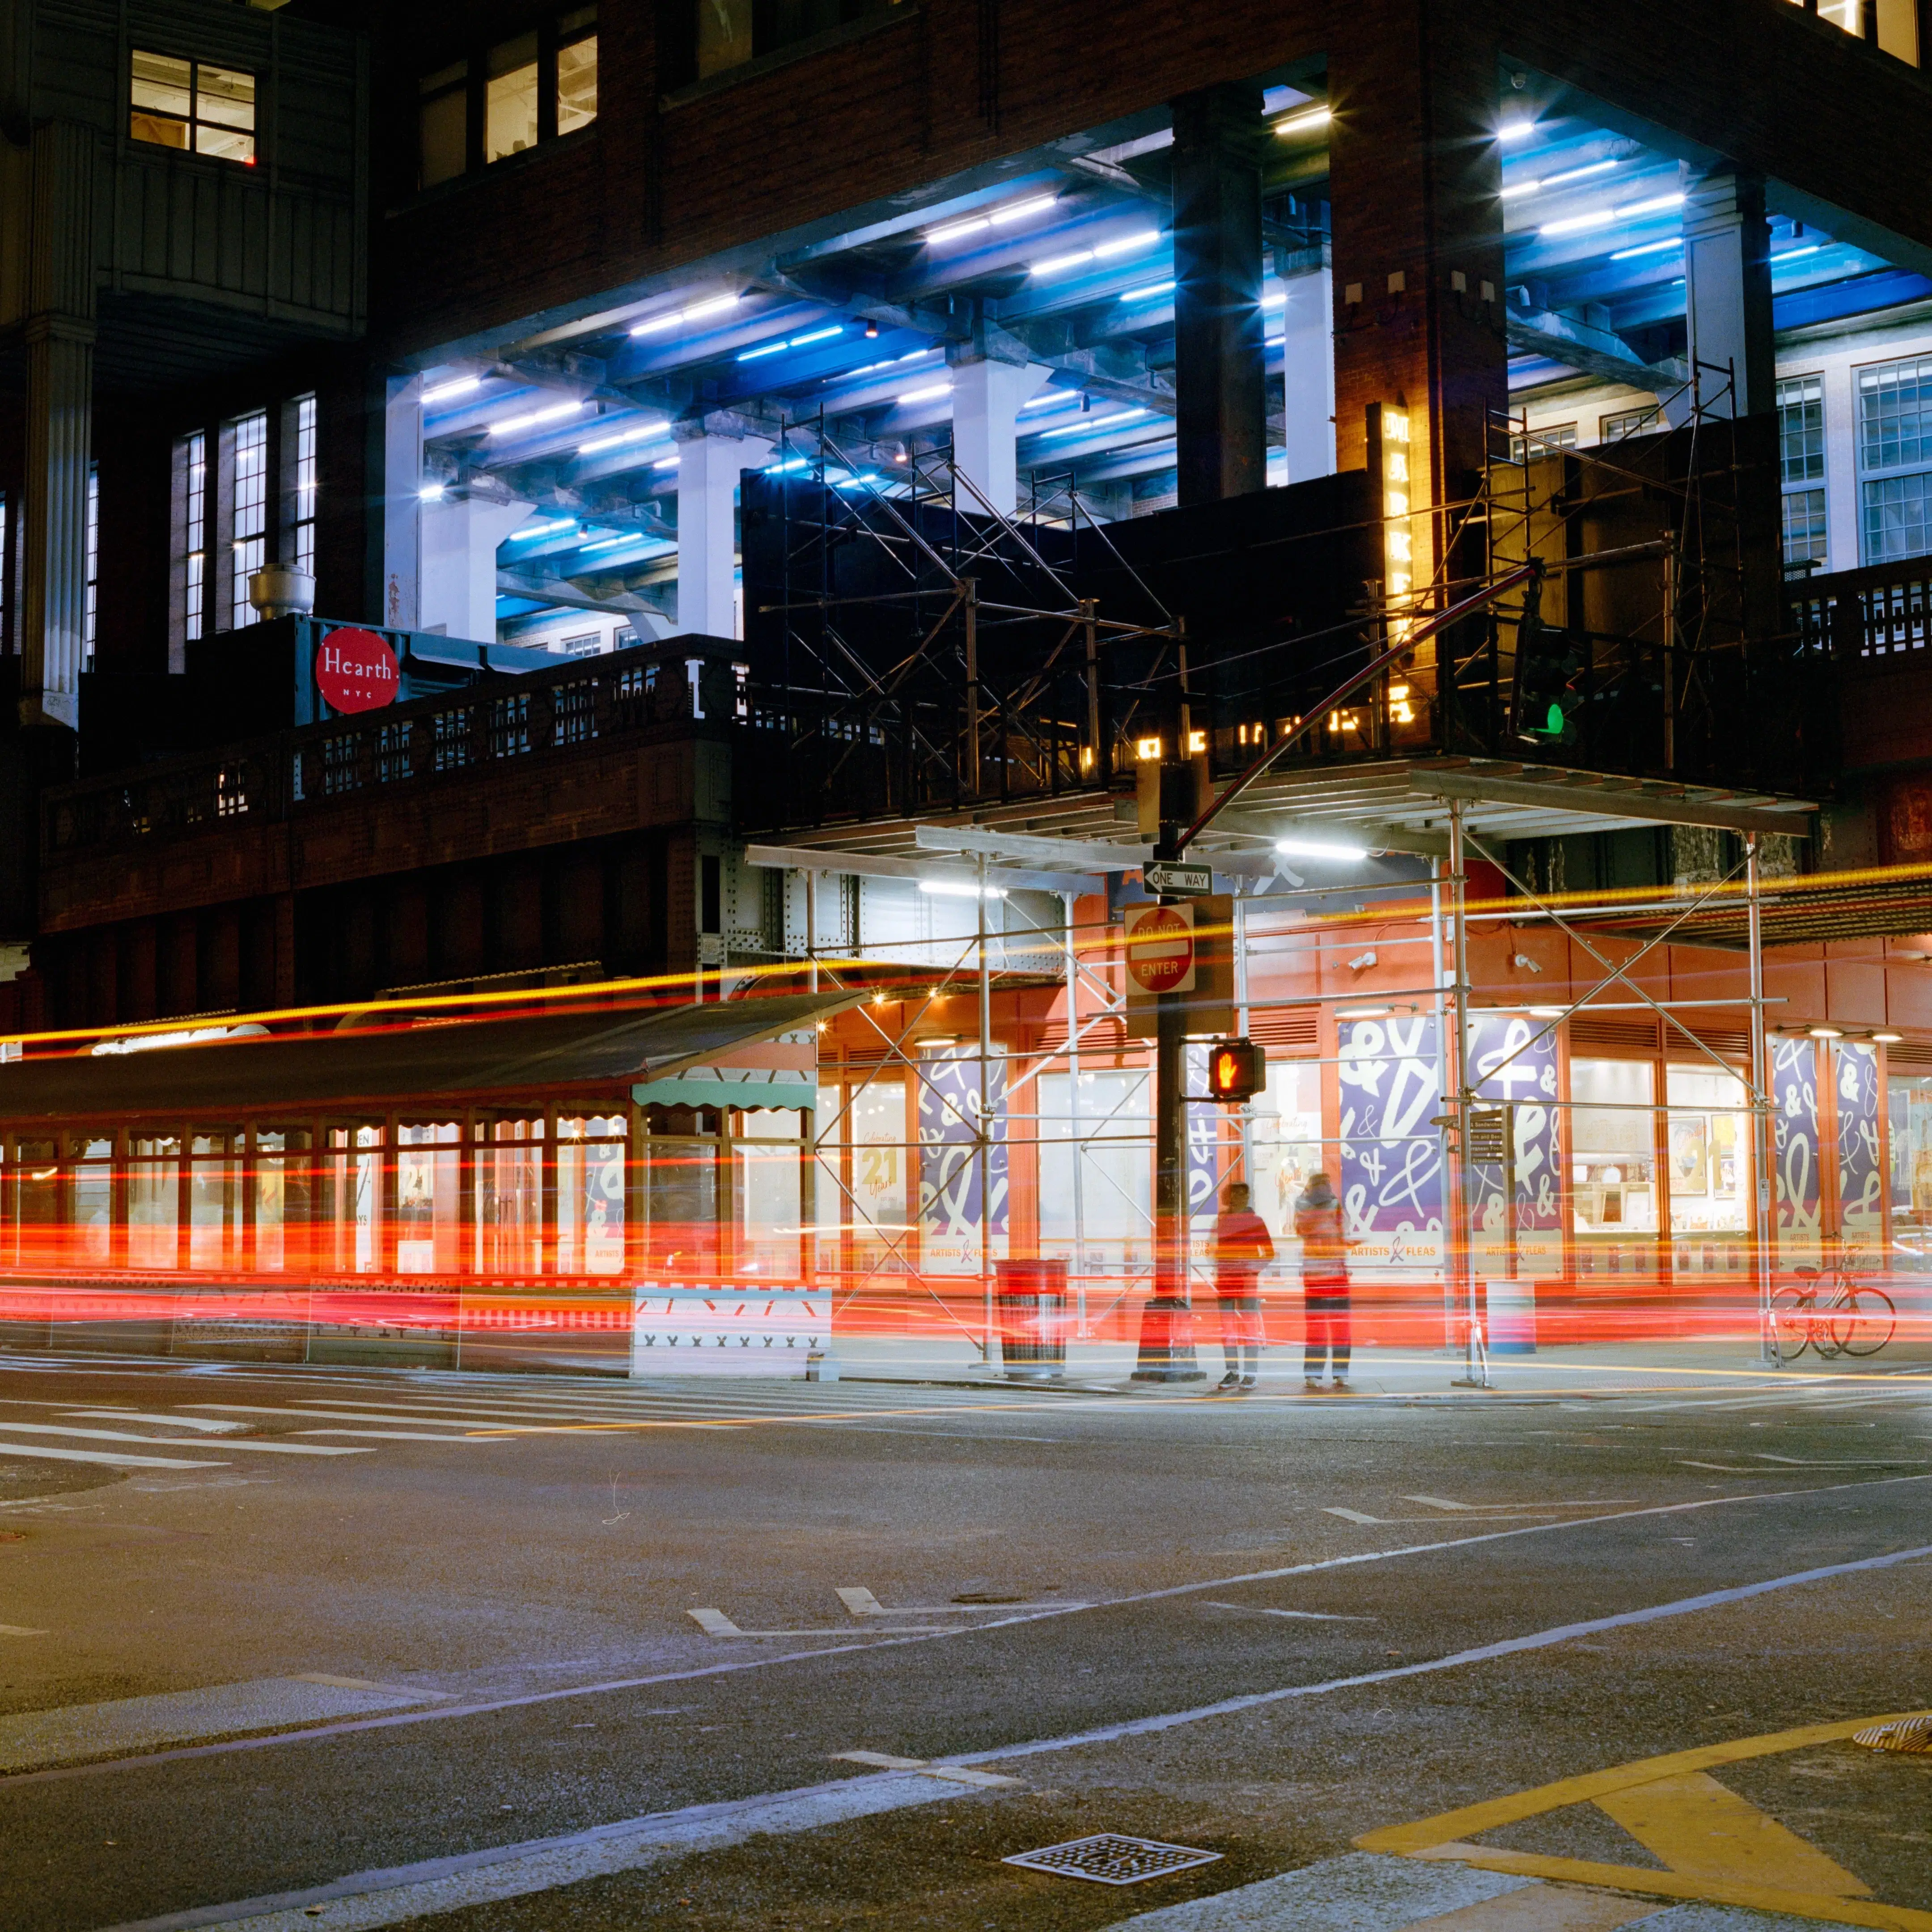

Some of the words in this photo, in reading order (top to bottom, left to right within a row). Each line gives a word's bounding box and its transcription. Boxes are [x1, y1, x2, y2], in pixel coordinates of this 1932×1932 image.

[325, 647, 391, 680] Hearth
[1152, 872, 1174, 885] ONE
[1185, 873, 1206, 888] WAY
[1138, 926, 1154, 938] DO
[1158, 923, 1180, 936] NOT
[1141, 961, 1178, 977] ENTER
[862, 1146, 897, 1184] 21
[930, 1248, 961, 1257] ARTISTS
[1351, 1246, 1390, 1256] ARTISTS
[1406, 1246, 1436, 1256] FLEAS
[1525, 1246, 1546, 1255] FLEAS
